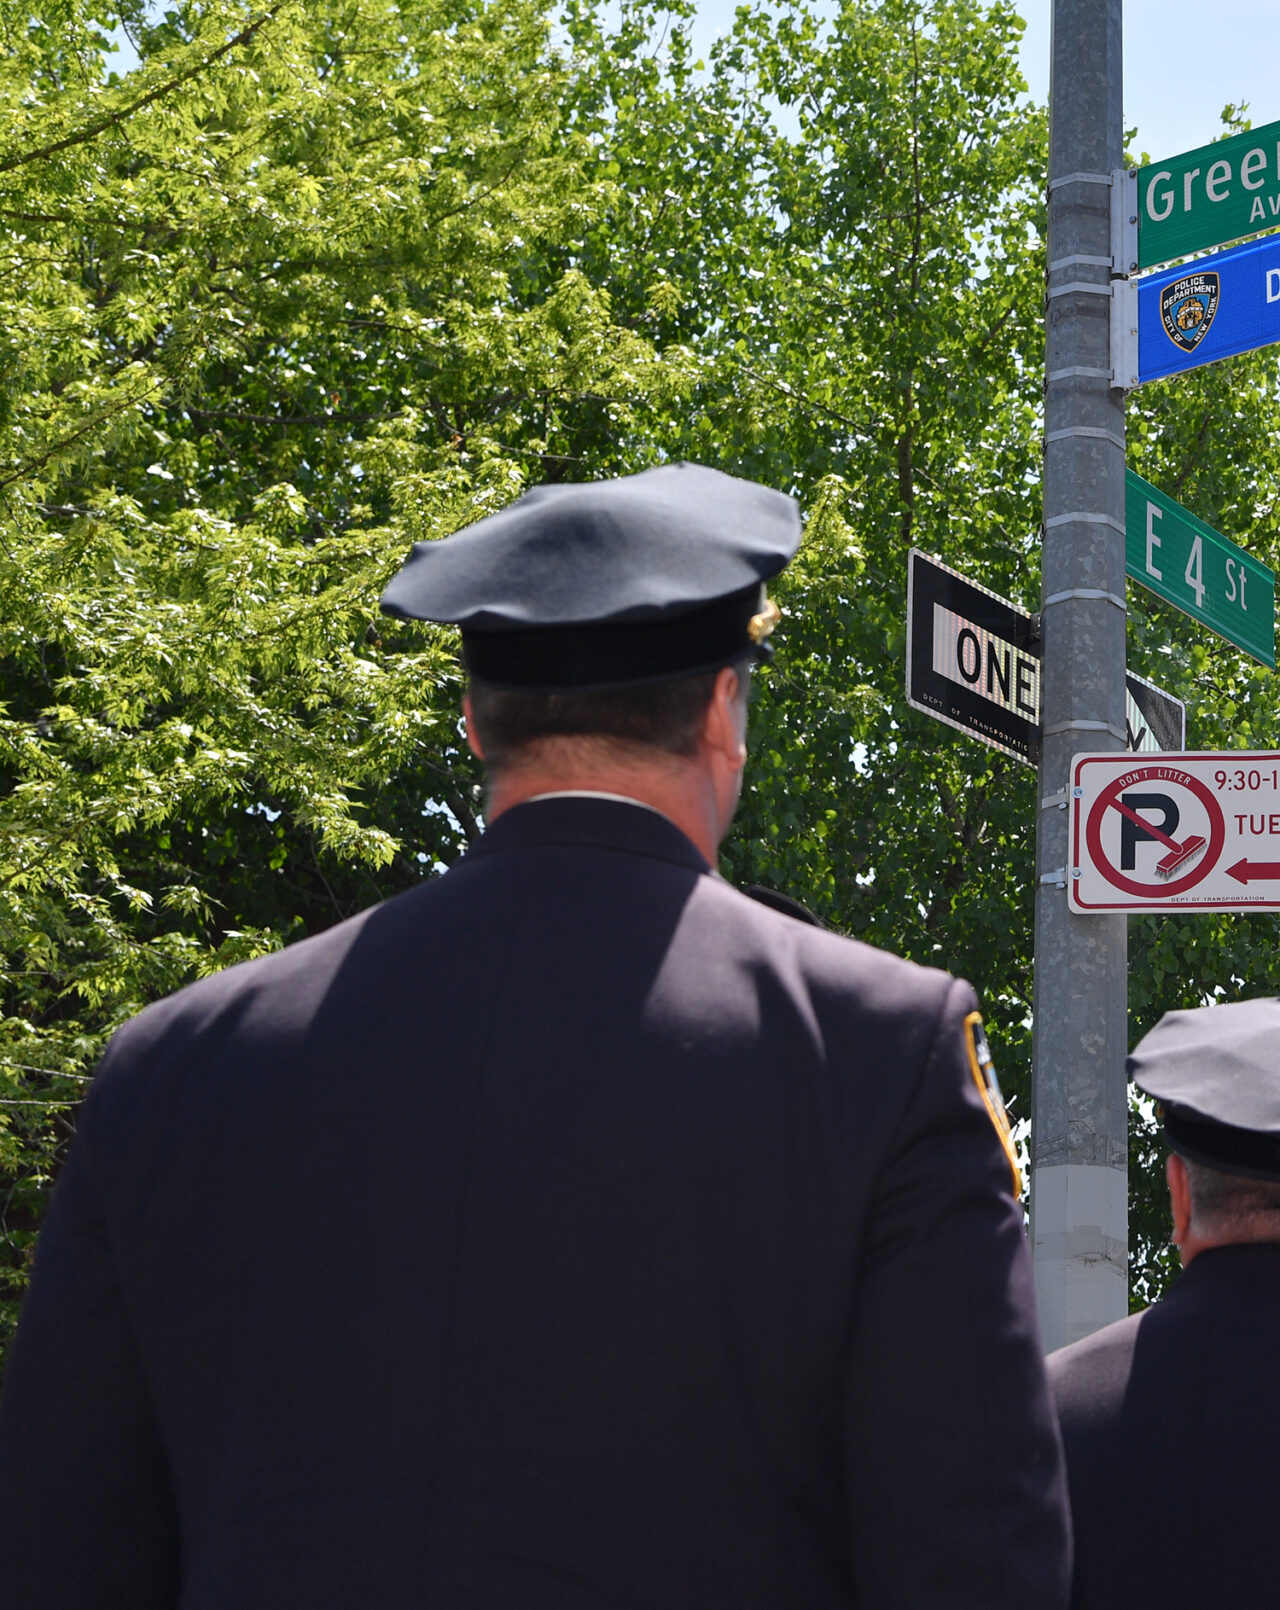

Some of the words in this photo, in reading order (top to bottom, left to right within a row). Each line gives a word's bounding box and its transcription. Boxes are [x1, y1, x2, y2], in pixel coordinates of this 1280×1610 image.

[1163, 285, 1216, 310] DEPARTMENT
[1174, 276, 1205, 292] POLICE
[1164, 315, 1175, 333] CITY
[1173, 334, 1184, 343] OF
[1194, 324, 1208, 342] NEW
[1205, 296, 1217, 319] YORK
[1146, 500, 1163, 582] E
[1184, 536, 1206, 608] 4
[1225, 558, 1247, 611] St
[957, 628, 1036, 718] ONE
[922, 693, 943, 707] DEPT
[951, 707, 960, 716] OF
[968, 716, 1029, 752] TRANSPORTATIO
[1119, 769, 1149, 787] DON'T
[1157, 769, 1191, 785] LITTER
[1121, 793, 1180, 871] P
